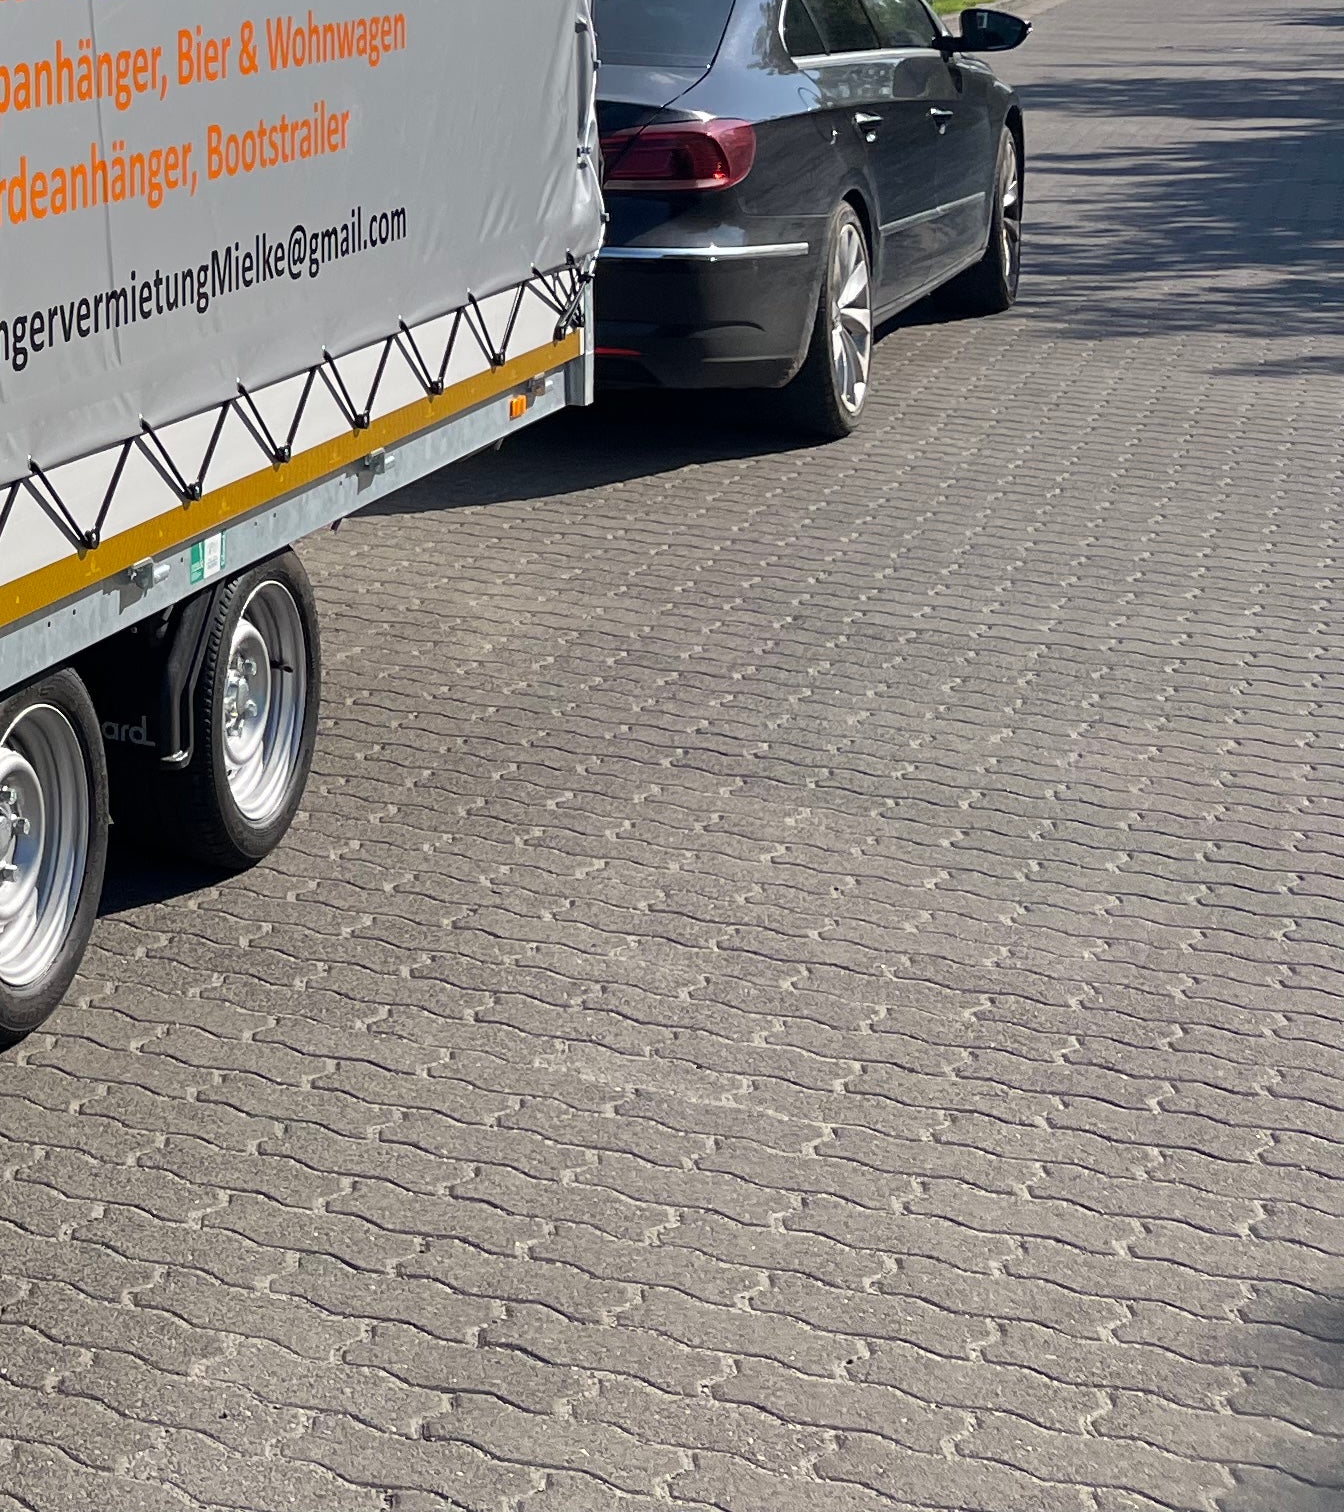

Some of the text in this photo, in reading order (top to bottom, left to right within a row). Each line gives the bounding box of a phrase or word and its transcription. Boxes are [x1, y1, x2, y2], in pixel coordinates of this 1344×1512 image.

[176, 26, 231, 87] Bier
[238, 19, 259, 77] &
[265, 9, 407, 70] Wohnwagen
[206, 99, 351, 182] Bootstrailer
